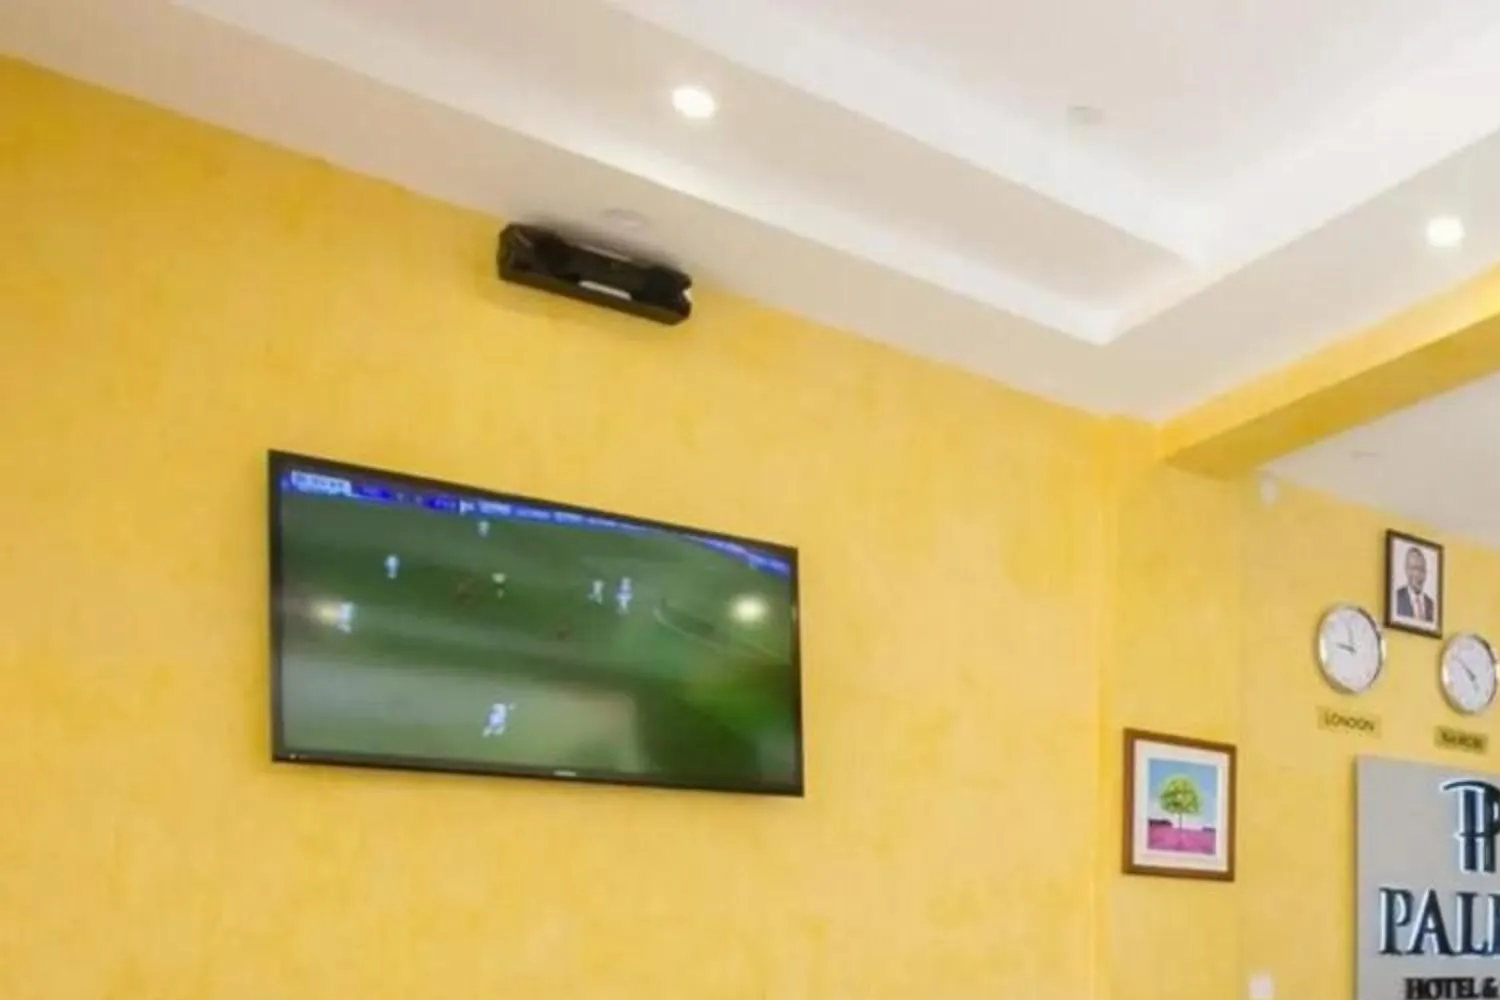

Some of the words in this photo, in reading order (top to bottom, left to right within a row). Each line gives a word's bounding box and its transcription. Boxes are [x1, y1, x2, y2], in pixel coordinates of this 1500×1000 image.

[1323, 710, 1376, 732] LONDON
[1403, 976, 1480, 1000] HOTEL
[1482, 976, 1499, 999] &
